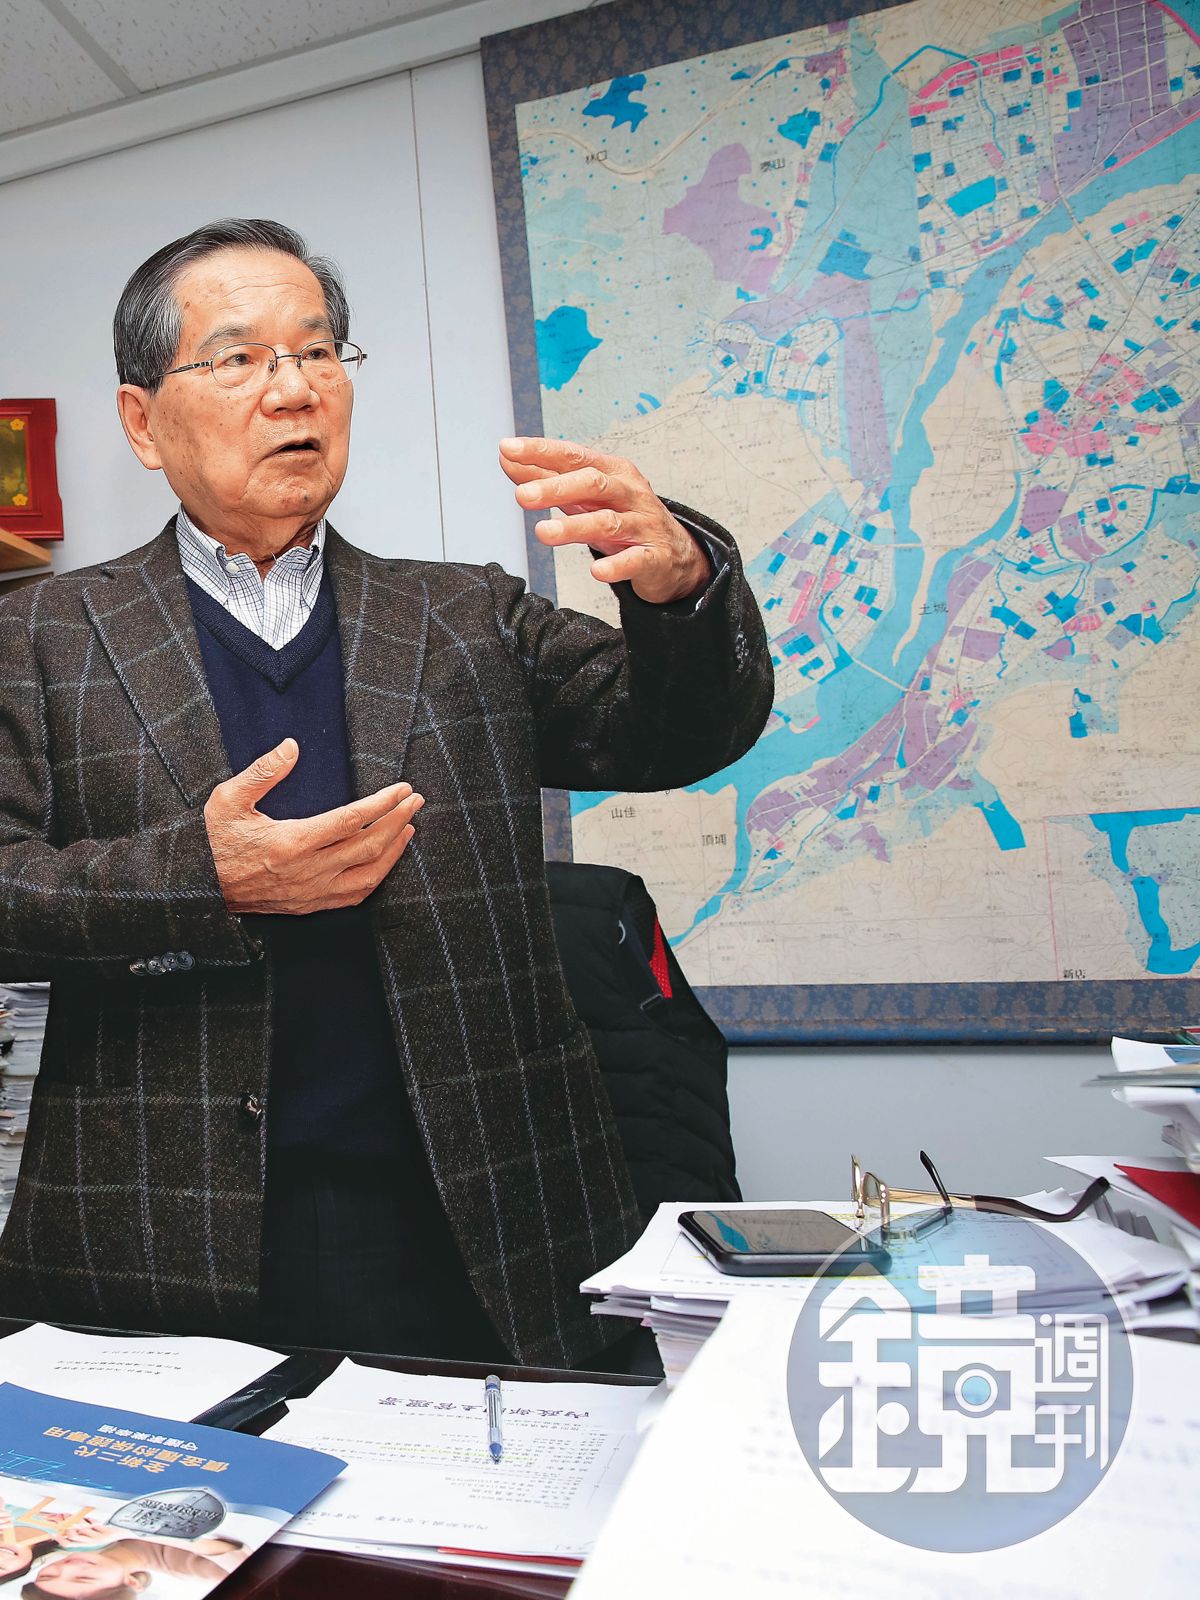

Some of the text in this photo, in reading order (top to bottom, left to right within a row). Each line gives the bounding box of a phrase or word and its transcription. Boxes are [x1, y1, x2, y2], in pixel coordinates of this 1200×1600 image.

[378, 1396, 590, 1420] 內政部土管理署
[42, 1426, 230, 1473] 價金履約保證專用
[73, 1445, 171, 1474] 全新二代
